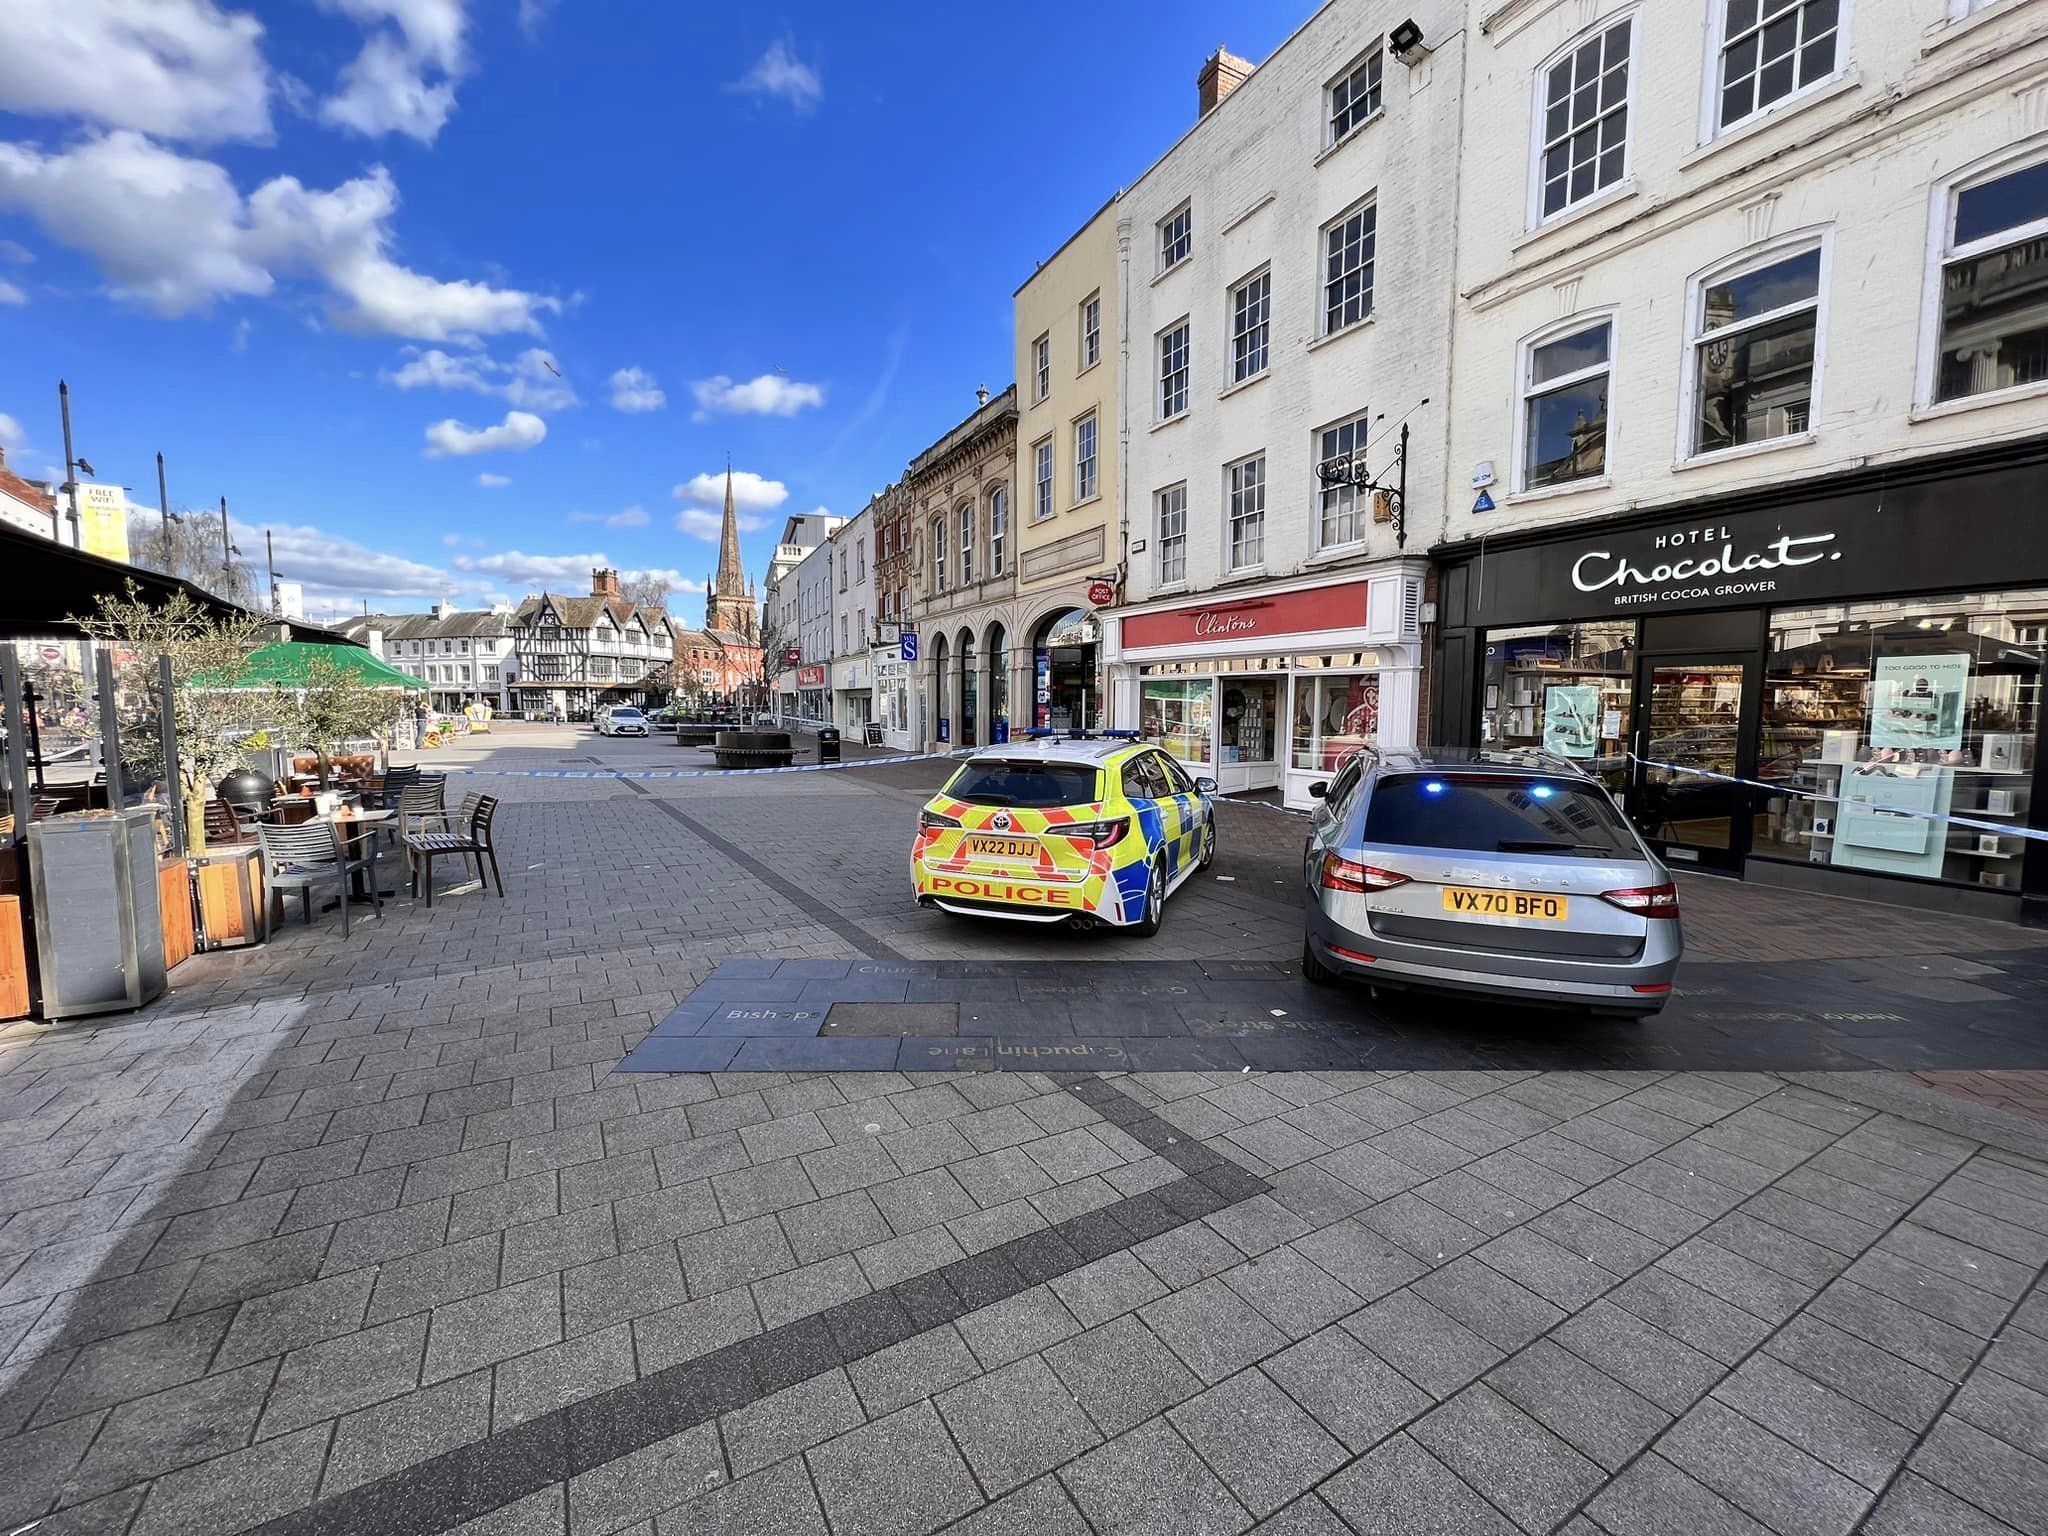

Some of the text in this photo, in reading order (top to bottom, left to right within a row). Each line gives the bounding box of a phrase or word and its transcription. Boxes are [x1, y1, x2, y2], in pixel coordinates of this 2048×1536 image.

[89, 489, 115, 497] FREE
[1655, 526, 1732, 549] HOTEL
[1091, 593, 1111, 601] OFFICE
[1614, 580, 1776, 605] BRITISH COCOA GROWER
[1194, 611, 1257, 637] Clintons
[903, 641, 916, 659] S
[972, 839, 1034, 857] VX22 DJJ
[932, 877, 1071, 904] POLICE
[1453, 892, 1558, 917] VX70 BFO
